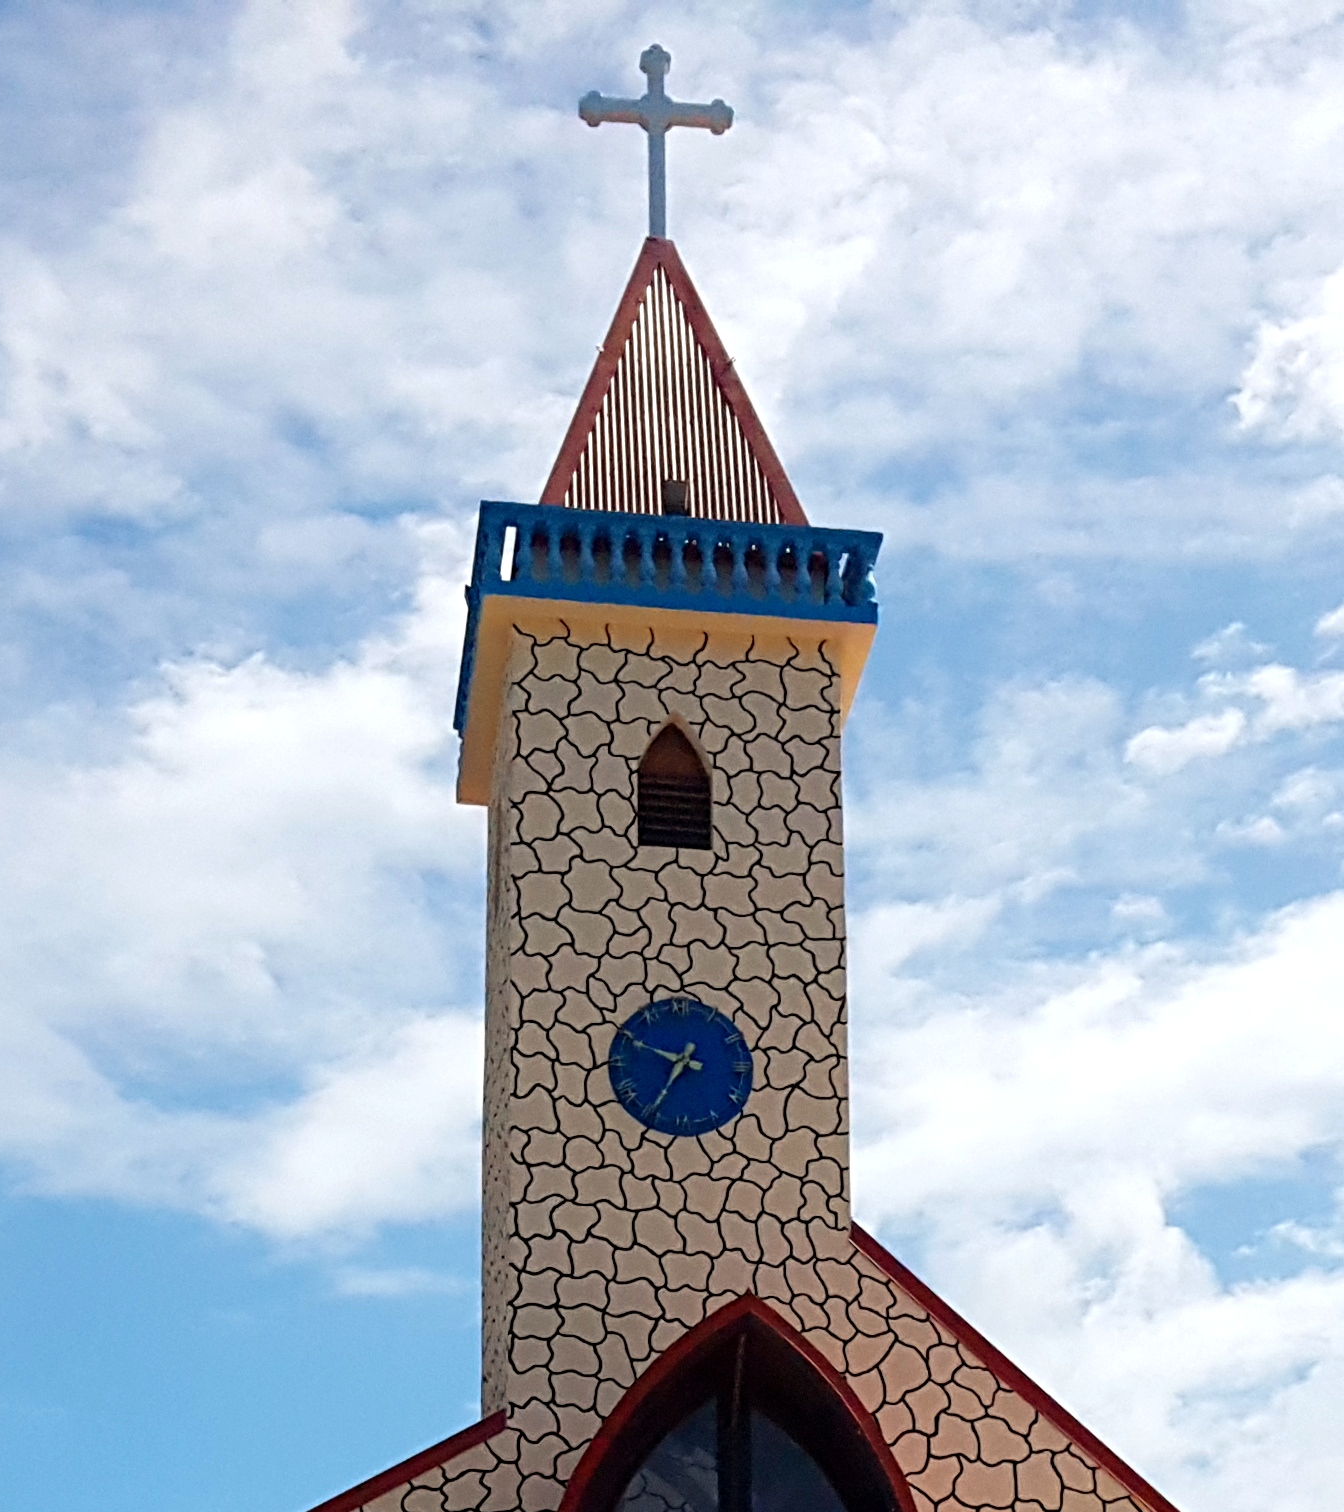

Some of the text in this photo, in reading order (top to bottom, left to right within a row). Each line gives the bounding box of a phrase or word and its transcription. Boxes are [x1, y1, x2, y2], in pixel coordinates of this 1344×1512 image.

[671, 1000, 689, 1017] XII
[724, 1032, 741, 1044] II
[732, 1061, 751, 1072] III
